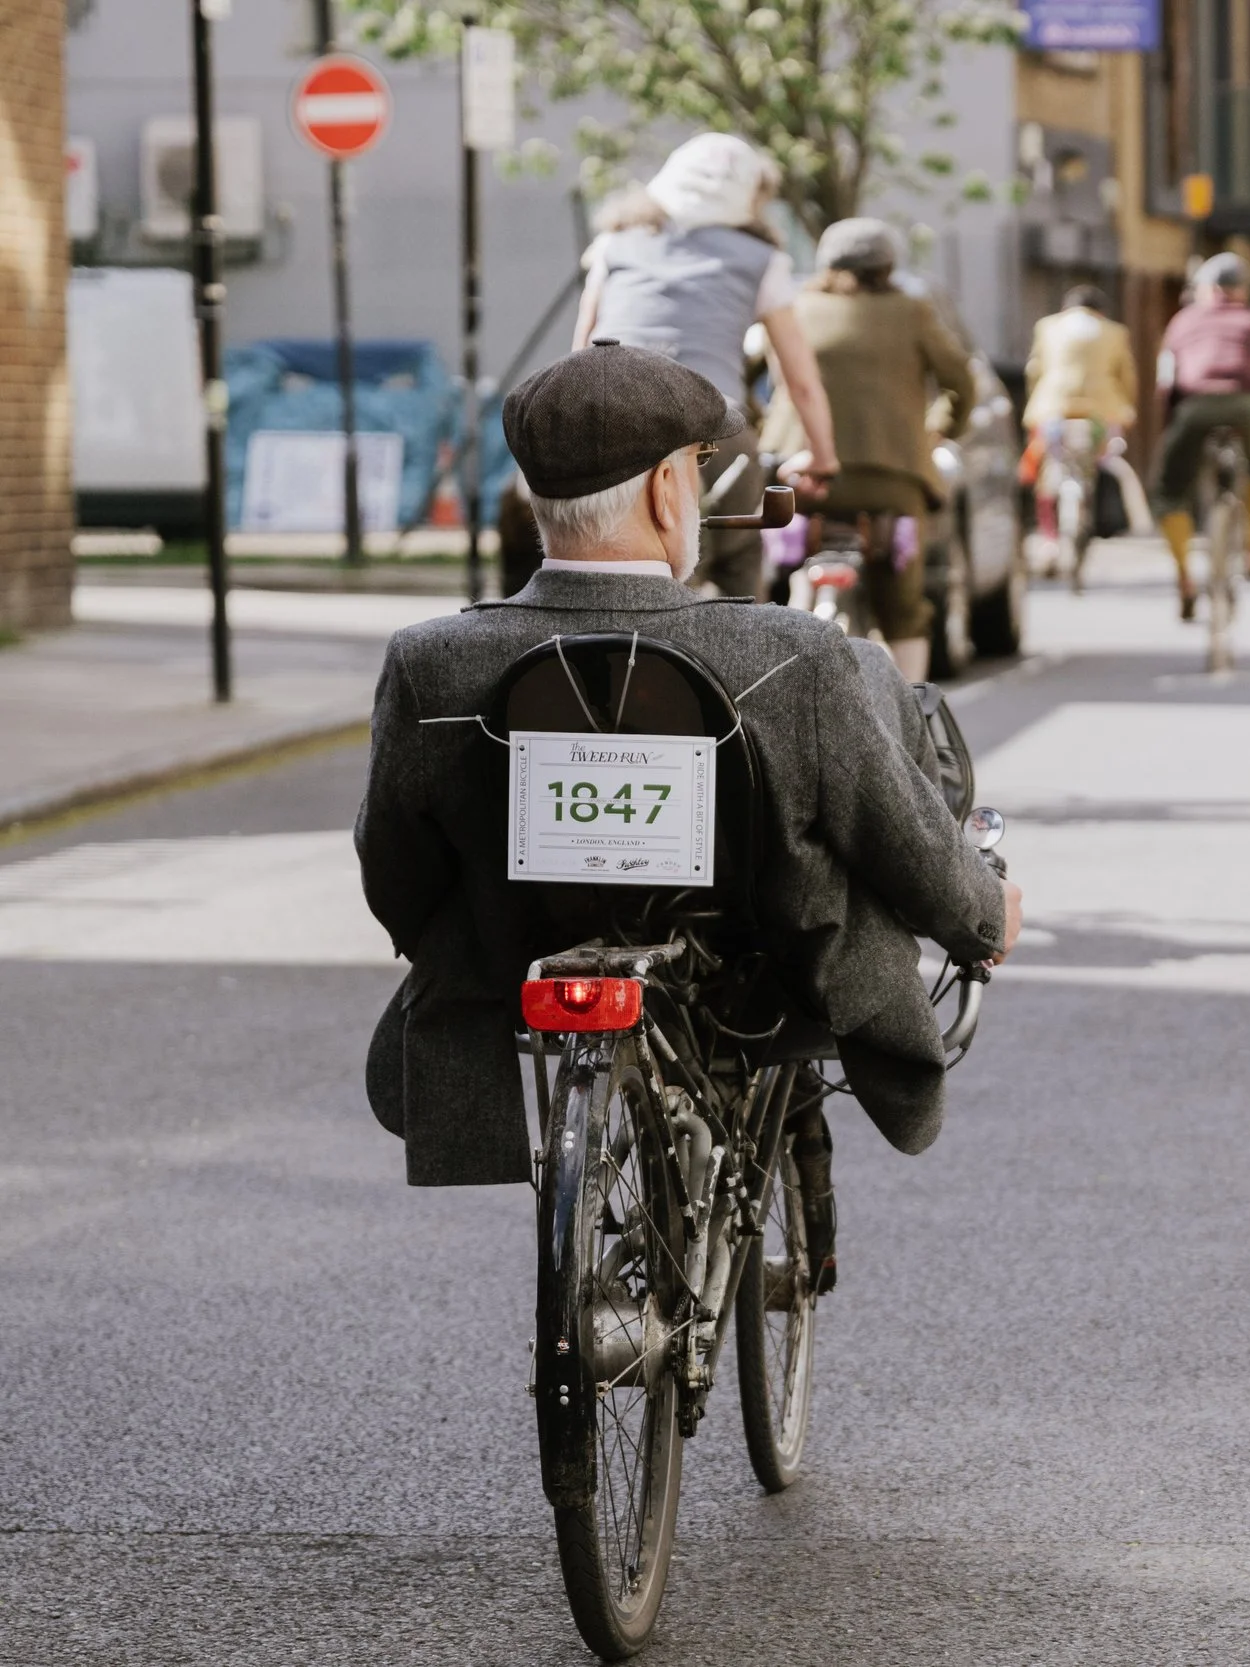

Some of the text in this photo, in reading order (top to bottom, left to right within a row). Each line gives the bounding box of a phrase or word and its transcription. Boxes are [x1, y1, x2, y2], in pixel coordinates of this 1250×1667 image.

[569, 751, 651, 764] TWEED RUN
[519, 756, 527, 786] BICYCLE
[696, 762, 704, 779] RIDE
[696, 782, 704, 801] WITH
[548, 781, 672, 824] 1847
[519, 788, 527, 848] METROPOLITAN
[695, 824, 703, 835] OF
[695, 837, 703, 860] STYLE
